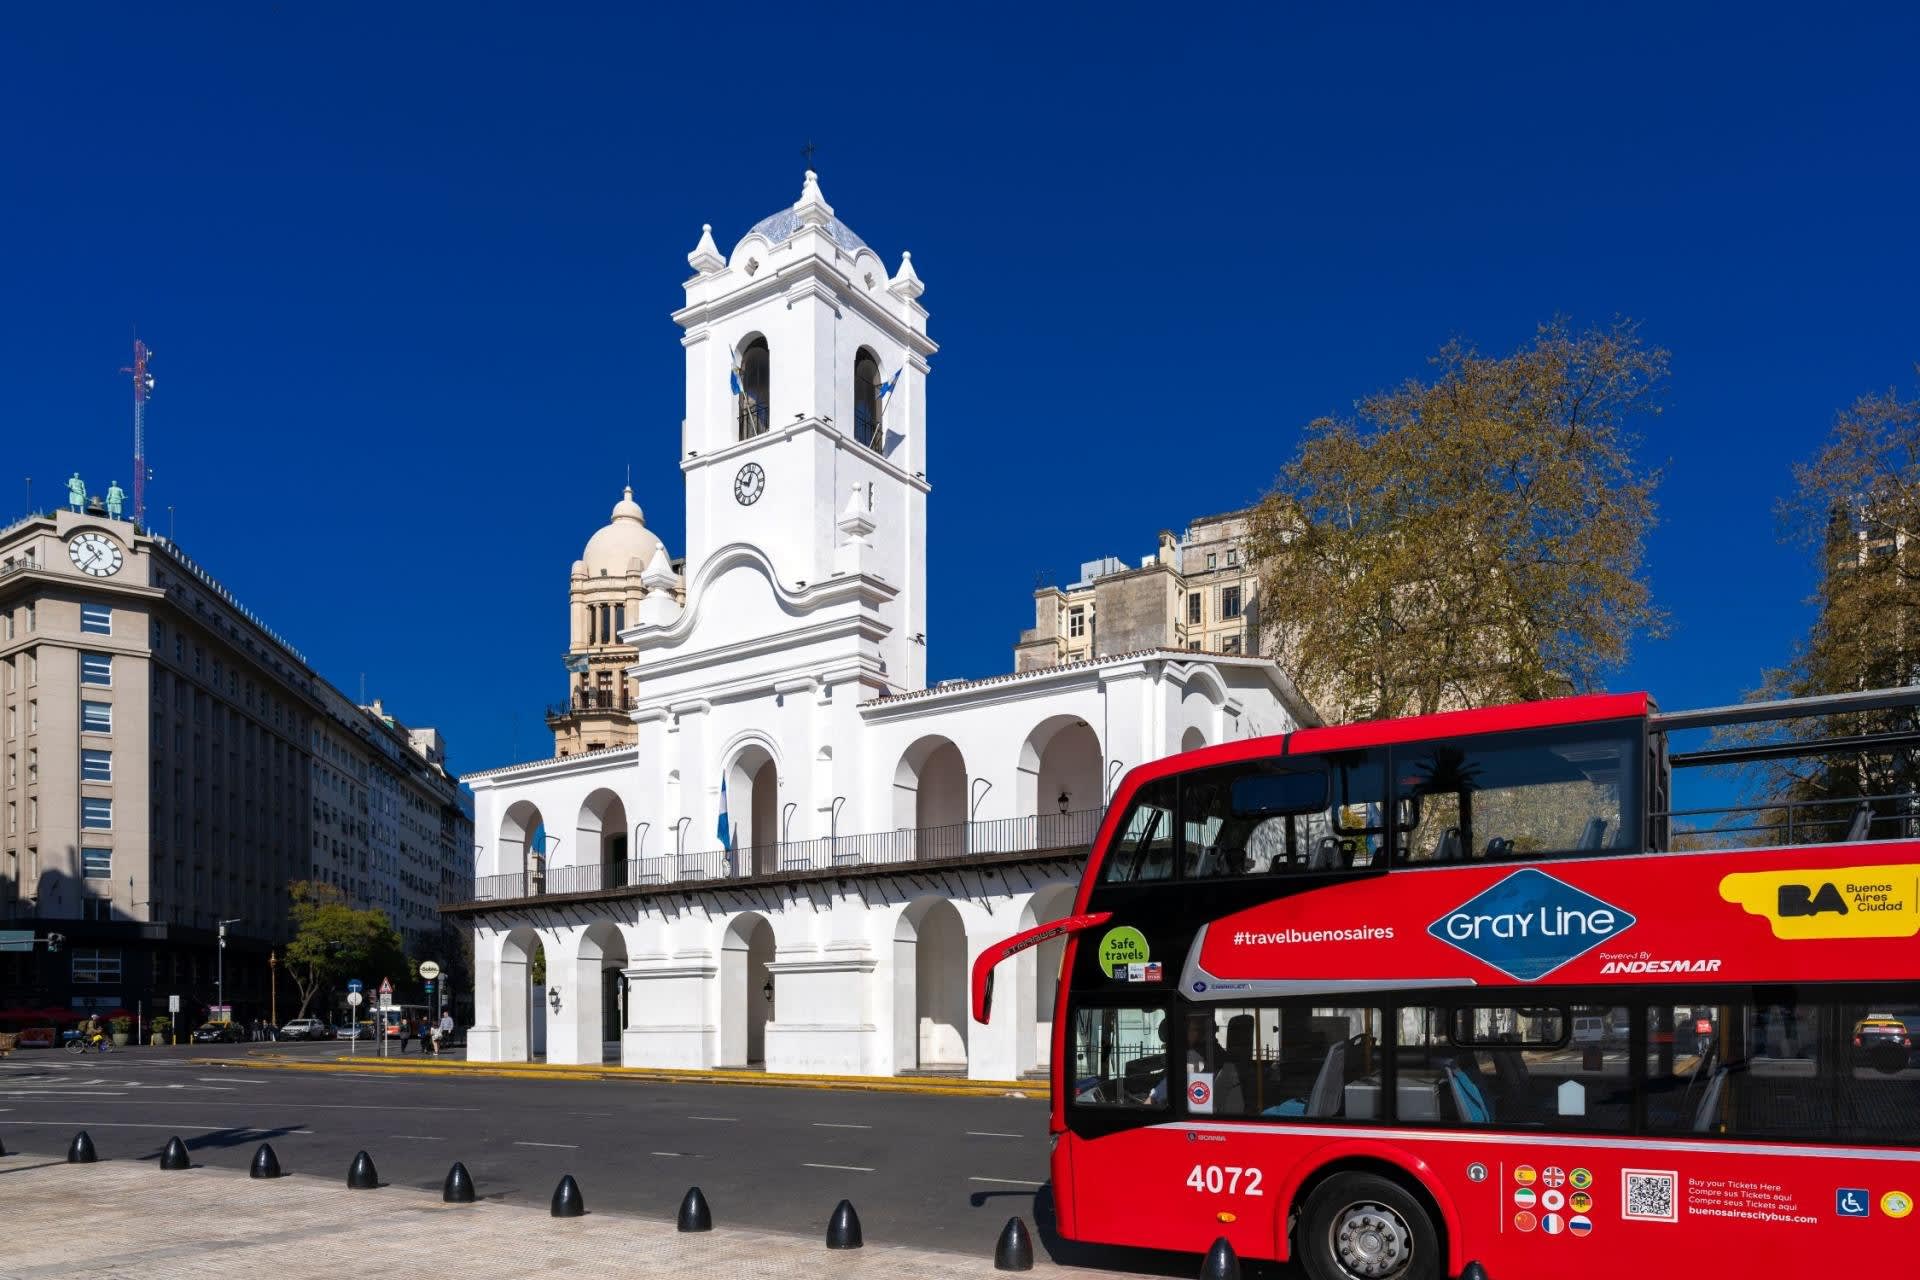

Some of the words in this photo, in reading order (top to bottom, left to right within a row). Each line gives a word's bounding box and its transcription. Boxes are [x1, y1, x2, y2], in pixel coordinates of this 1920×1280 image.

[1846, 884, 1892, 893] Buenos
[1777, 882, 1849, 917] BA
[1854, 893, 1888, 902] Aires
[1857, 901, 1903, 912] Ciudad
[1446, 913, 1534, 940] Gray
[1540, 906, 1615, 936] Line
[1233, 925, 1394, 945] #travelbuenosaires
[1110, 938, 1135, 950] Safe
[1105, 948, 1144, 961] travels
[1600, 952, 1638, 960] Powered
[1639, 951, 1652, 960] By
[1600, 960, 1722, 974] ANDESMAR
[1186, 1164, 1264, 1196] 4072
[1688, 1178, 1705, 1187] Buy
[1706, 1180, 1726, 1188] your
[1728, 1180, 1758, 1190] Tickets
[1760, 1183, 1781, 1192] Here
[1688, 1187, 1722, 1196] Compre
[1741, 1190, 1771, 1200] Tickets
[1688, 1196, 1722, 1205] Compre
[1723, 1199, 1744, 1207] seus
[1746, 1200, 1776, 1209] Tickets
[1688, 1206, 1818, 1224] buenosairescitybus.com
